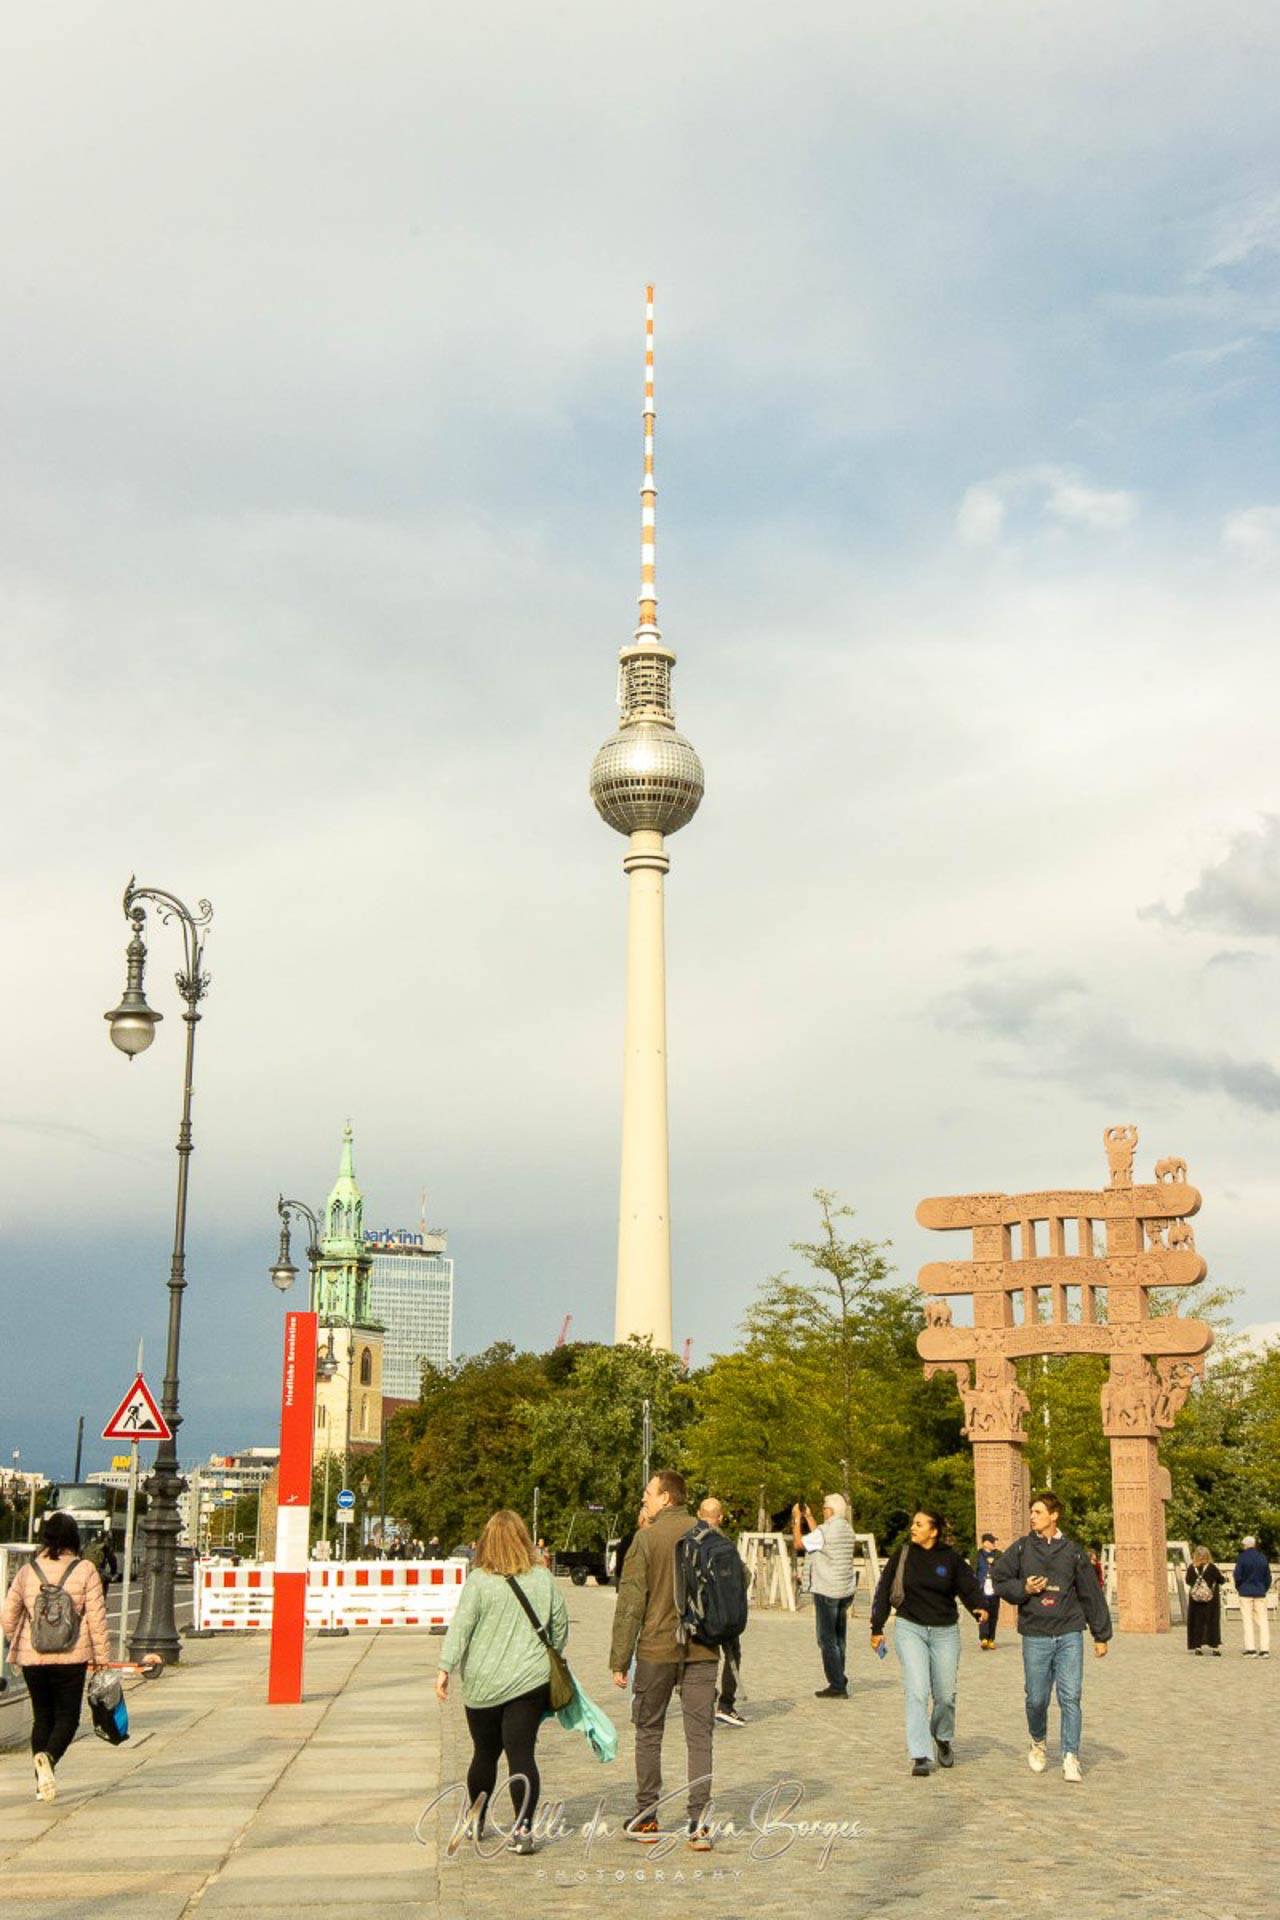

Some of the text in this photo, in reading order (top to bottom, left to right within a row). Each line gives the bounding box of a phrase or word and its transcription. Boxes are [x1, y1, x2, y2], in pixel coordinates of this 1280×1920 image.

[398, 1229, 423, 1245] inn
[285, 1316, 297, 1406] Friedliche Revolution
